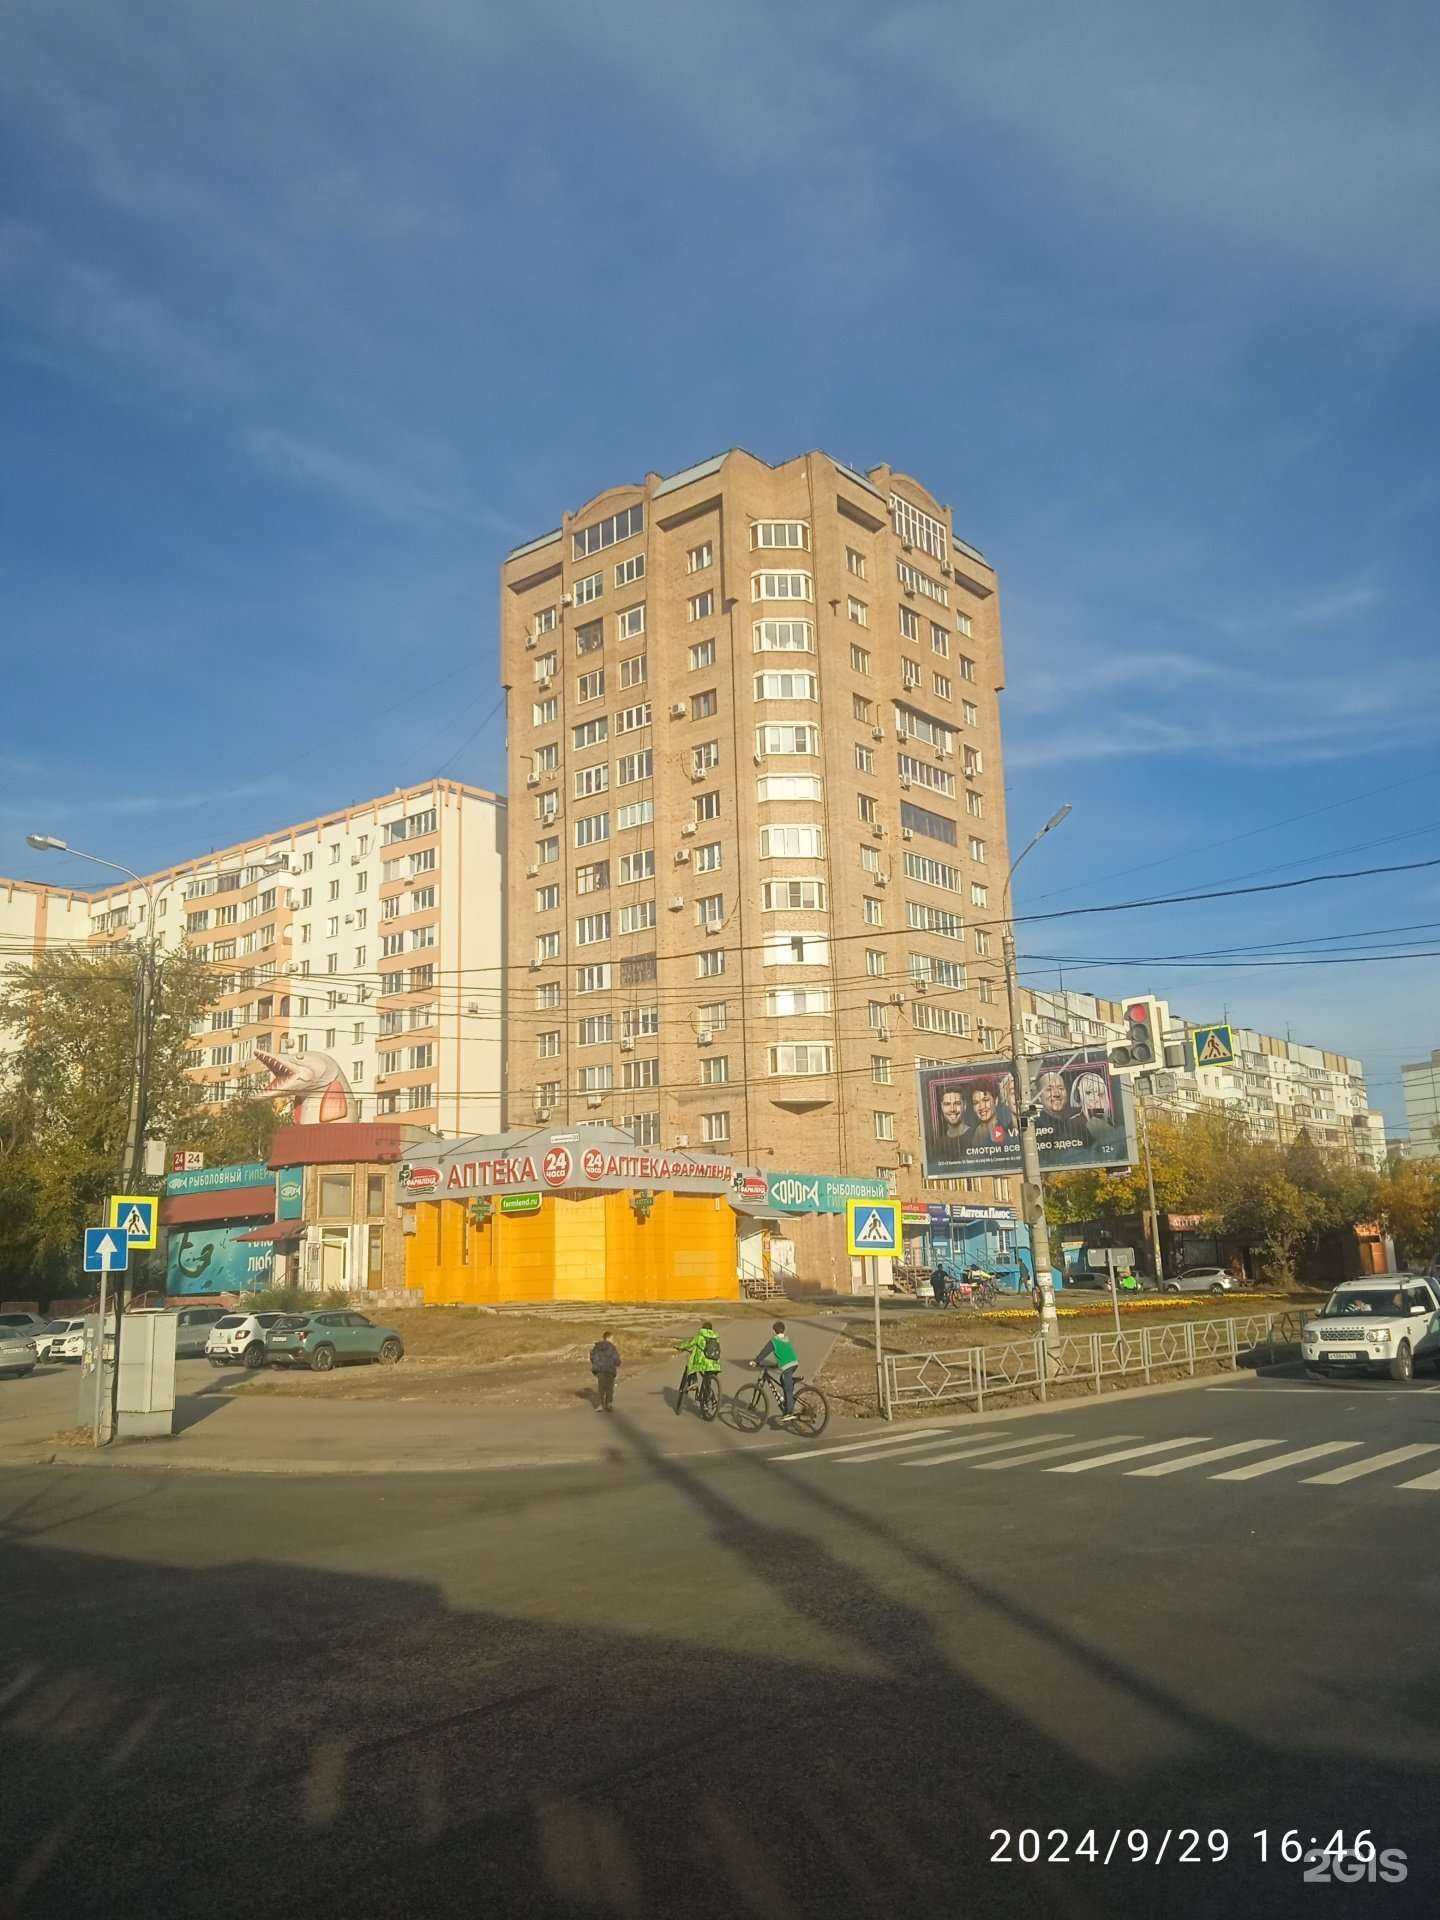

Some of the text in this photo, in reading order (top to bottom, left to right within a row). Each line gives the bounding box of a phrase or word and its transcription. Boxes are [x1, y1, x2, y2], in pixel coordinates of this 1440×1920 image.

[966, 1145, 1002, 1156] смотри
[1003, 1144, 1021, 1153] все
[1054, 1139, 1084, 1150] здесь
[1101, 1145, 1114, 1153] 12+
[188, 1153, 201, 1164] 24
[547, 1152, 567, 1171] 24
[587, 1153, 603, 1168] 24
[447, 1156, 539, 1190] АПТЕКА
[605, 1155, 732, 1182] АПТЕКА ФАРМЛЕНД
[188, 1169, 242, 1188] РЫБОЛОВНЫЙ
[770, 1179, 820, 1207] СОРОГА
[826, 1182, 885, 1198] РЫБОЛОВНЫЙ
[247, 1250, 273, 1272] люб
